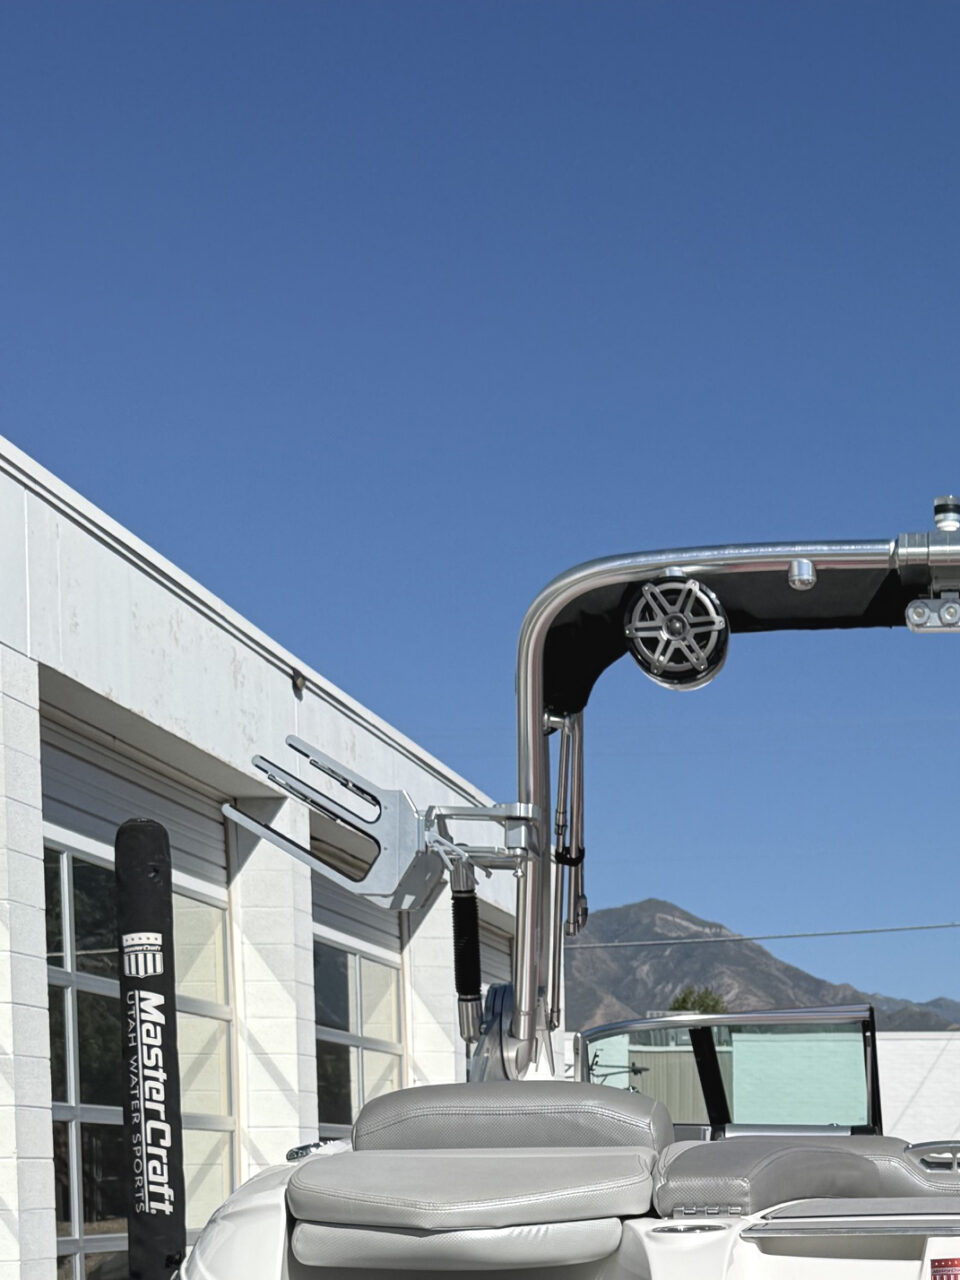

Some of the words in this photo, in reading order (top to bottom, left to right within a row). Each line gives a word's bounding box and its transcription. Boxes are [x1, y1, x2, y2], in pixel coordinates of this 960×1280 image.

[126, 990, 138, 1047] UTAH
[128, 1055, 141, 1125] WATER
[139, 989, 175, 1216] MasterCraft
[131, 1133, 145, 1214] SPORTS
